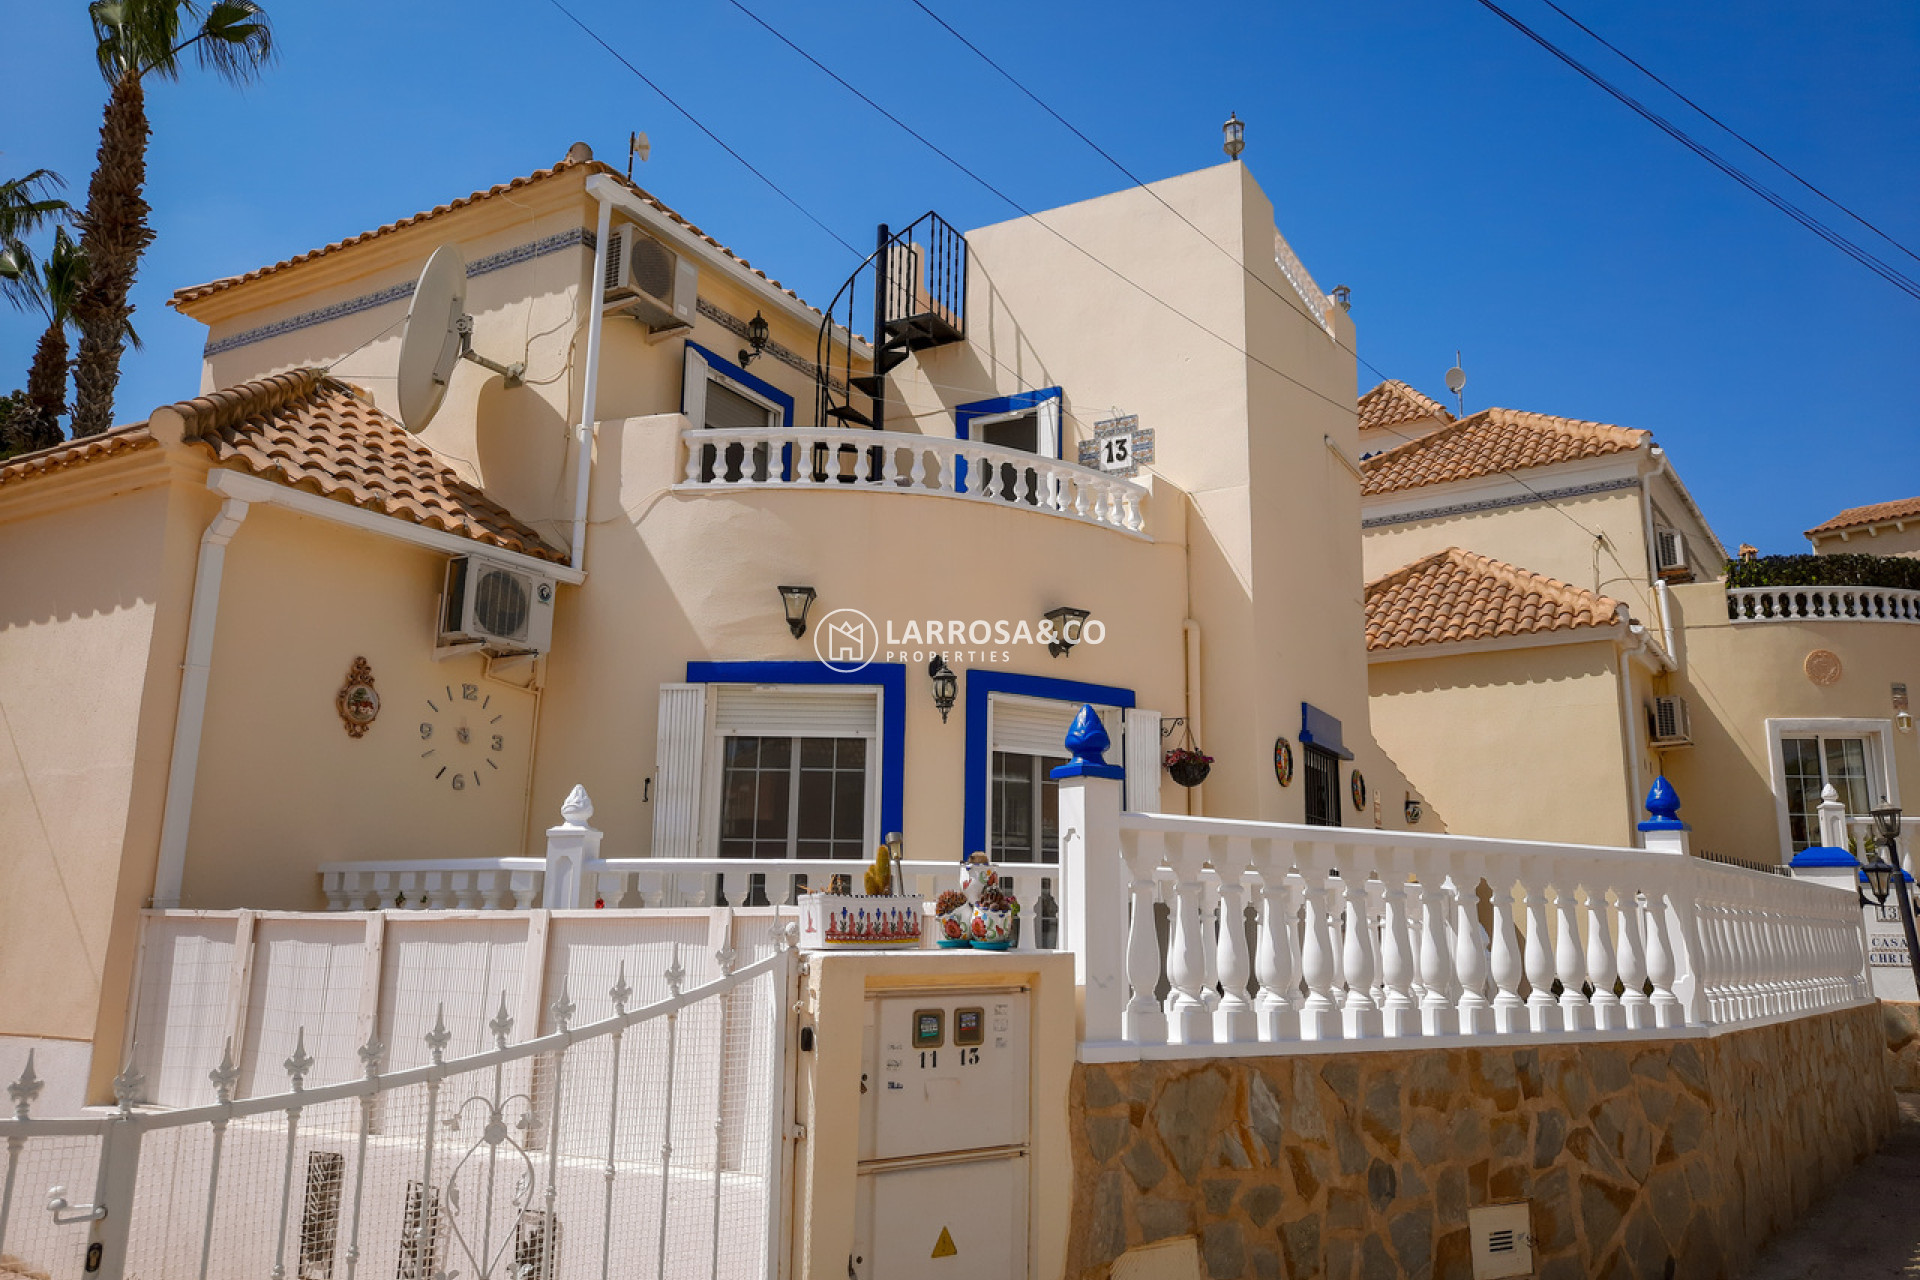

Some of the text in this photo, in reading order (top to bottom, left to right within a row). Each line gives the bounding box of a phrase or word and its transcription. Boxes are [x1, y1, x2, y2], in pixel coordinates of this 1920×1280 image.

[1105, 439, 1127, 463] 13
[462, 683, 478, 700] 12
[420, 722, 433, 740] 9
[491, 735, 503, 751] 3
[452, 773, 465, 790] 6
[1871, 938, 1909, 947] CASA
[918, 1050, 937, 1069] 11
[960, 1047, 980, 1066] 13
